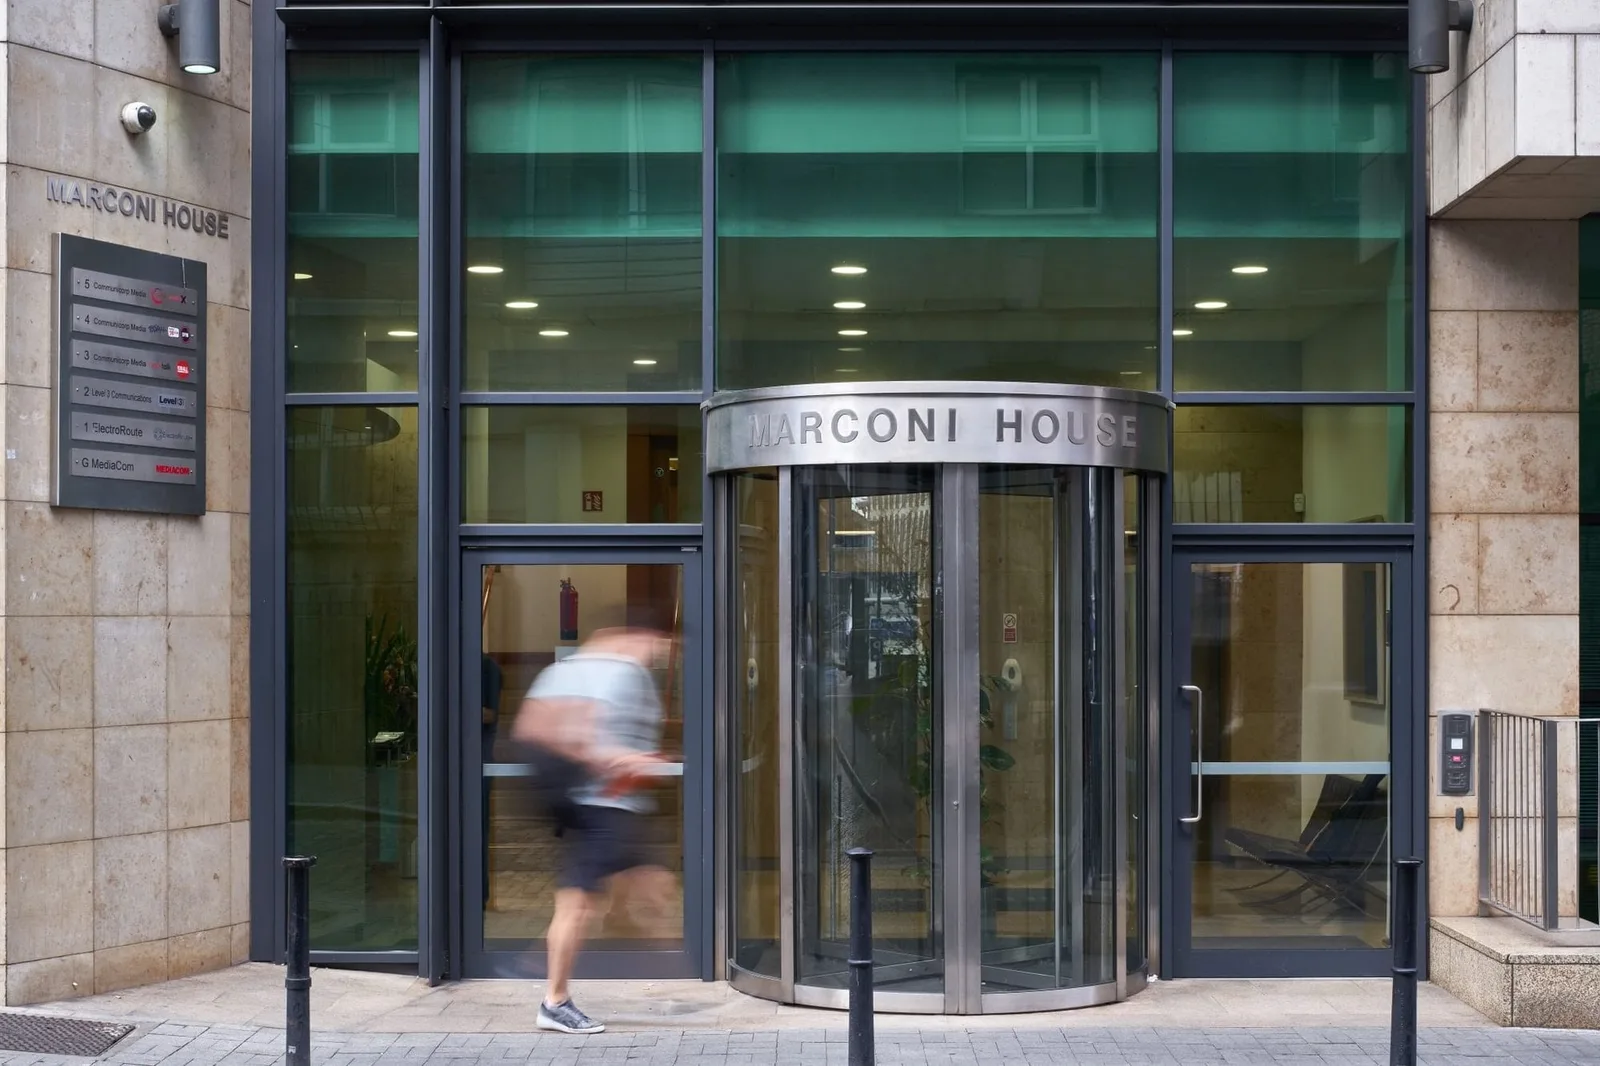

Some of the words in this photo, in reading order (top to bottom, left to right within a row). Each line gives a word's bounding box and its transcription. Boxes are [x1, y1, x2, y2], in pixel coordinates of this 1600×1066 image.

[46, 176, 156, 222] MARCONI
[163, 201, 229, 239] HOUSE
[84, 279, 90, 289] 5
[93, 282, 130, 295] Communicorp
[131, 289, 146, 297] Media
[84, 314, 90, 324] 4
[94, 318, 130, 330] Communicorp
[131, 324, 146, 332] Media
[84, 350, 90, 360] 3
[93, 354, 130, 366] Communicorp
[131, 359, 146, 367] Media
[84, 387, 89, 396] 2
[91, 388, 105, 396] Level
[111, 391, 152, 404] Communications
[159, 396, 177, 405] Level
[84, 422, 88, 432] 1
[92, 423, 143, 437] ElectroRoute
[748, 408, 957, 448] MARCONI
[995, 408, 1138, 448] HOUSE
[82, 458, 89, 468] G
[92, 459, 134, 471] MediaCom
[156, 465, 190, 475] MEDIACOM
